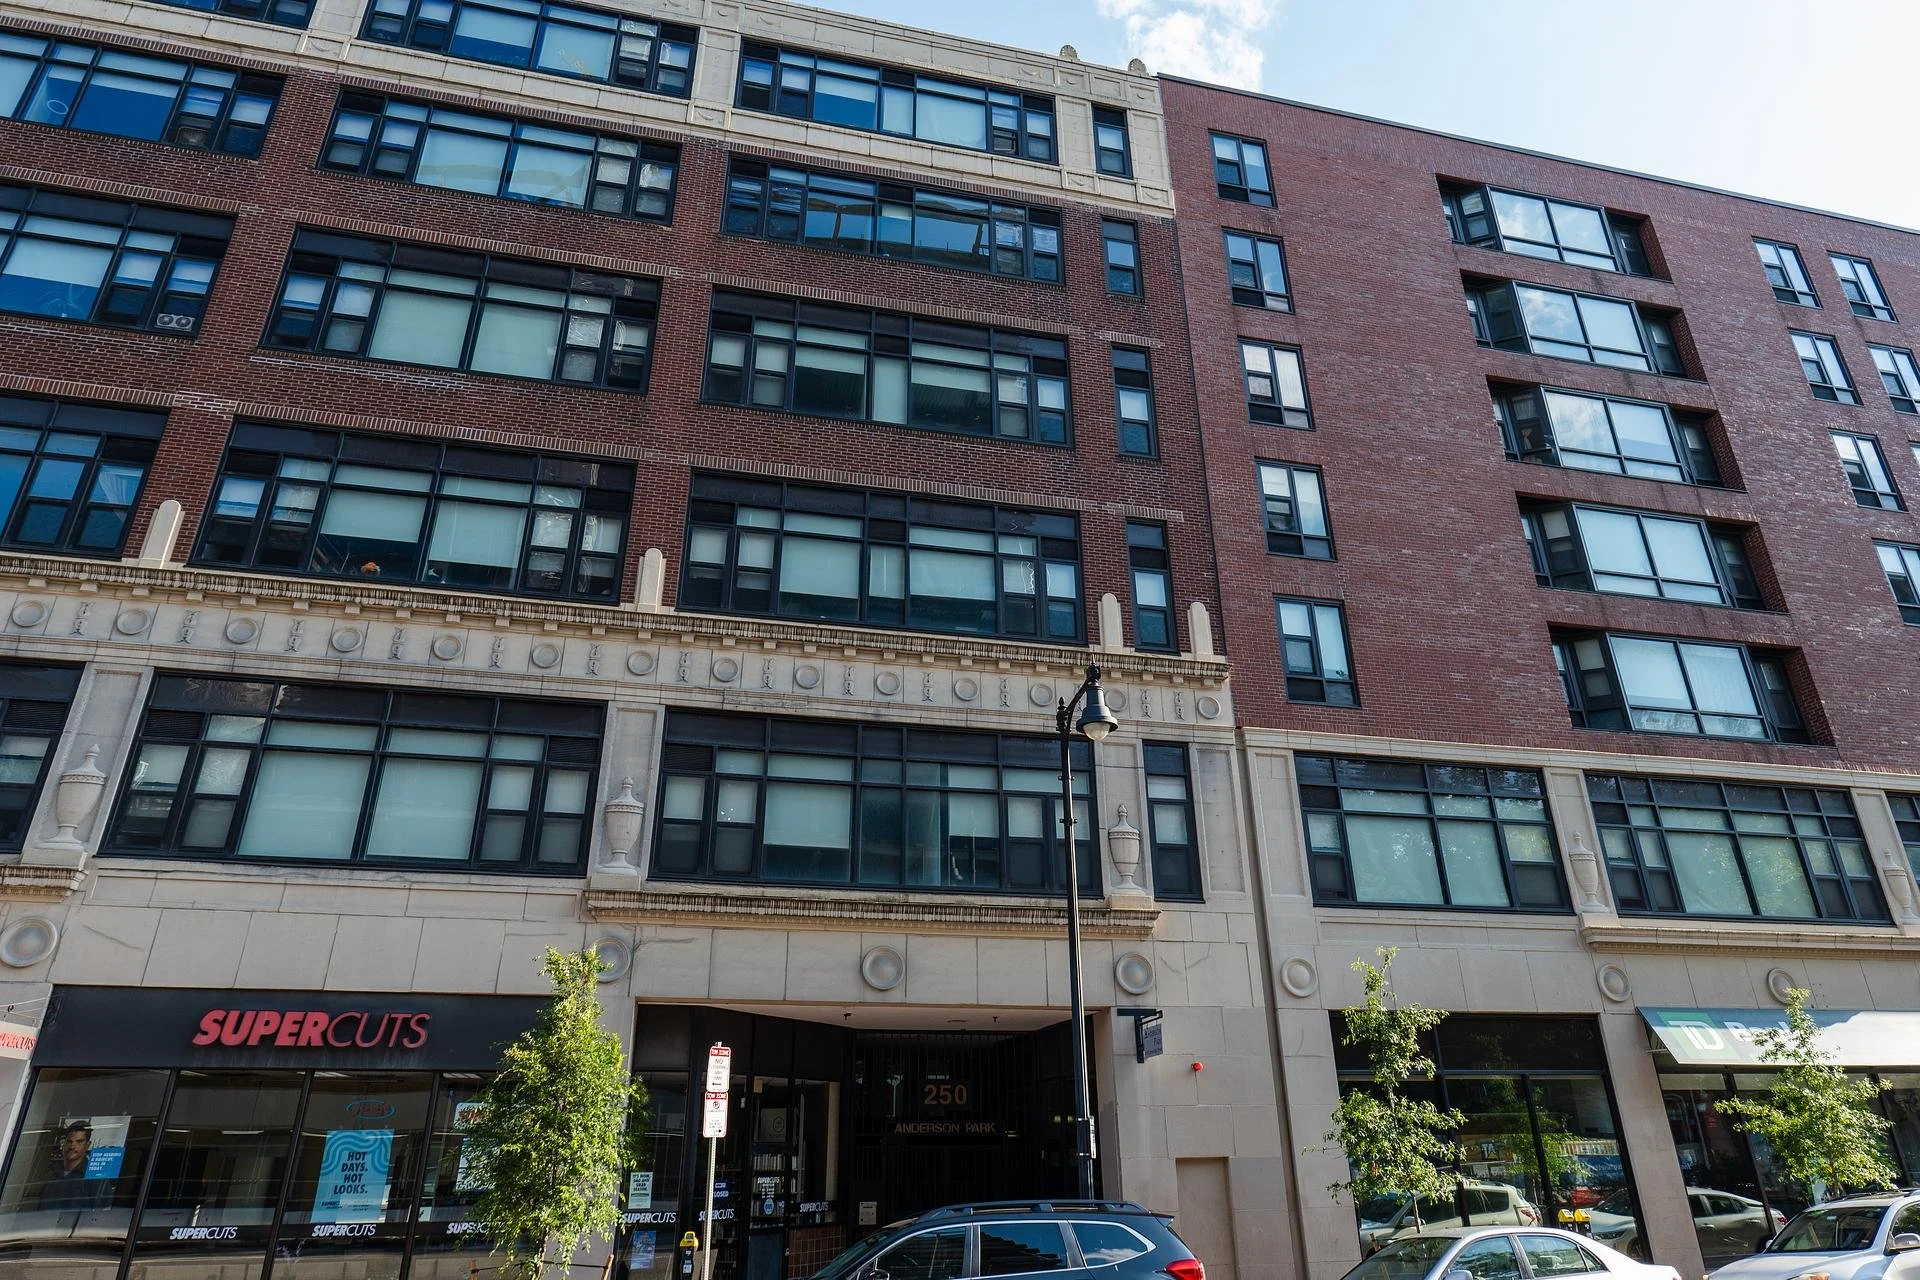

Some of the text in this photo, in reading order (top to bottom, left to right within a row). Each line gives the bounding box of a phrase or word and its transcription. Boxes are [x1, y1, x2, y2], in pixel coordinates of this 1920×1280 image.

[192, 1009, 432, 1048] SUPERCUTS
[0, 1031, 36, 1051] UPERCUTS
[924, 1084, 968, 1105] 250
[894, 1122, 997, 1134] ANDERSON PARK
[347, 1151, 368, 1161] HOT
[341, 1162, 368, 1172] DAYS.
[343, 1173, 364, 1183] HOT
[333, 1184, 368, 1194] LOOKS.
[800, 1201, 829, 1213] SUPERCUTS
[699, 1208, 736, 1221] SUERCUTS
[169, 1226, 238, 1240] SUPERCUTS
[312, 1224, 377, 1237] SUPERCUTS
